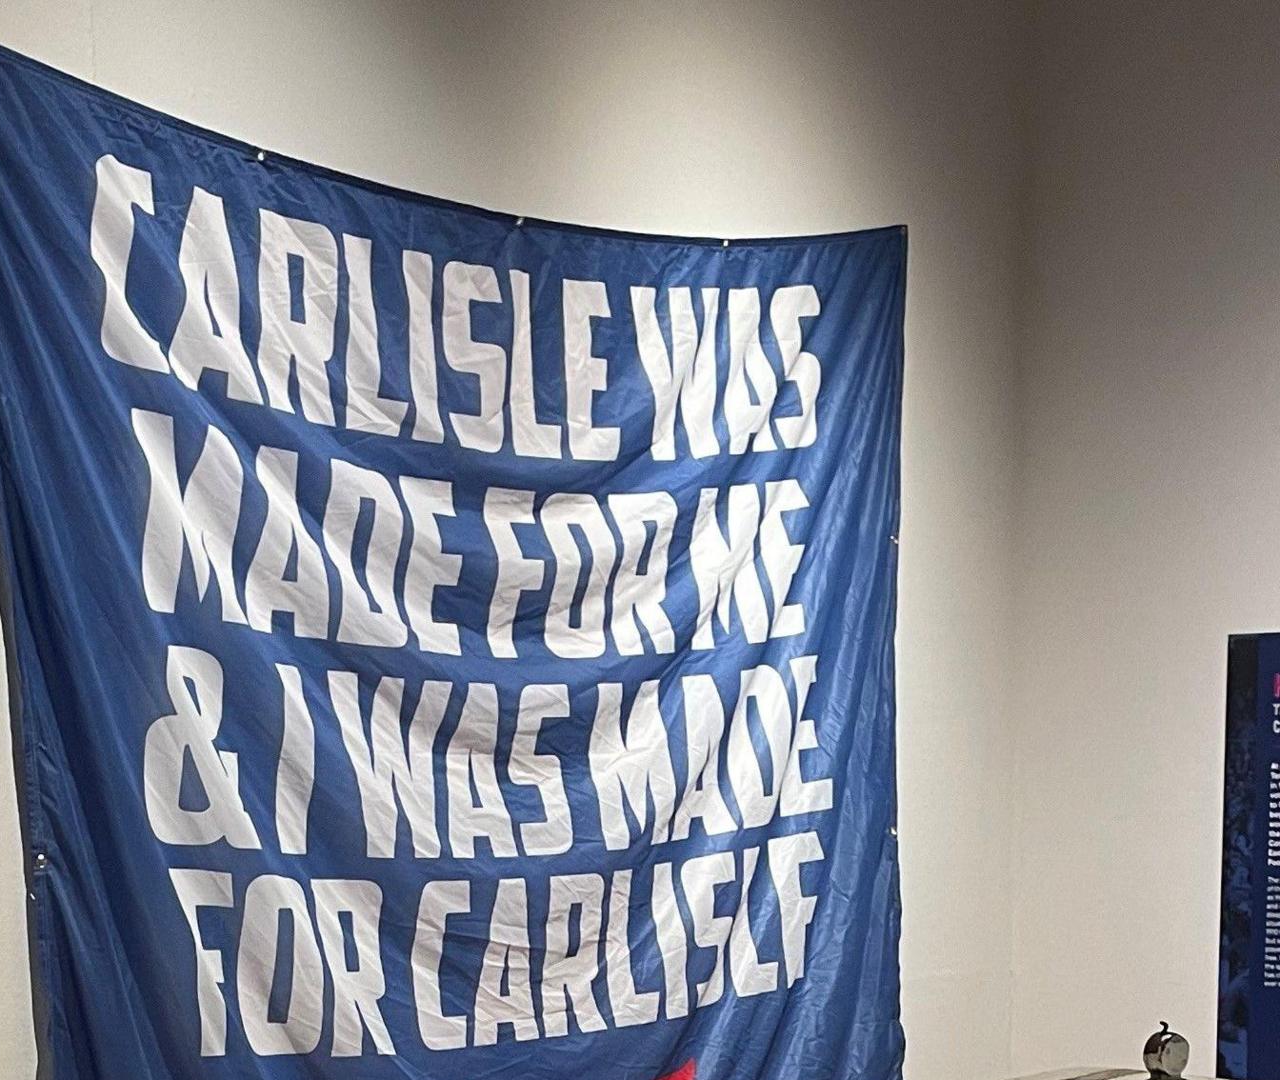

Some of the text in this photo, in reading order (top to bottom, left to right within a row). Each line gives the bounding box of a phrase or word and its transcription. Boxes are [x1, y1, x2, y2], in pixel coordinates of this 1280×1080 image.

[91, 154, 821, 461] CARLISLE WAS
[131, 408, 809, 658] MADE FOR ME
[144, 645, 833, 859] & I WAS MADE
[168, 868, 397, 1057] FOR
